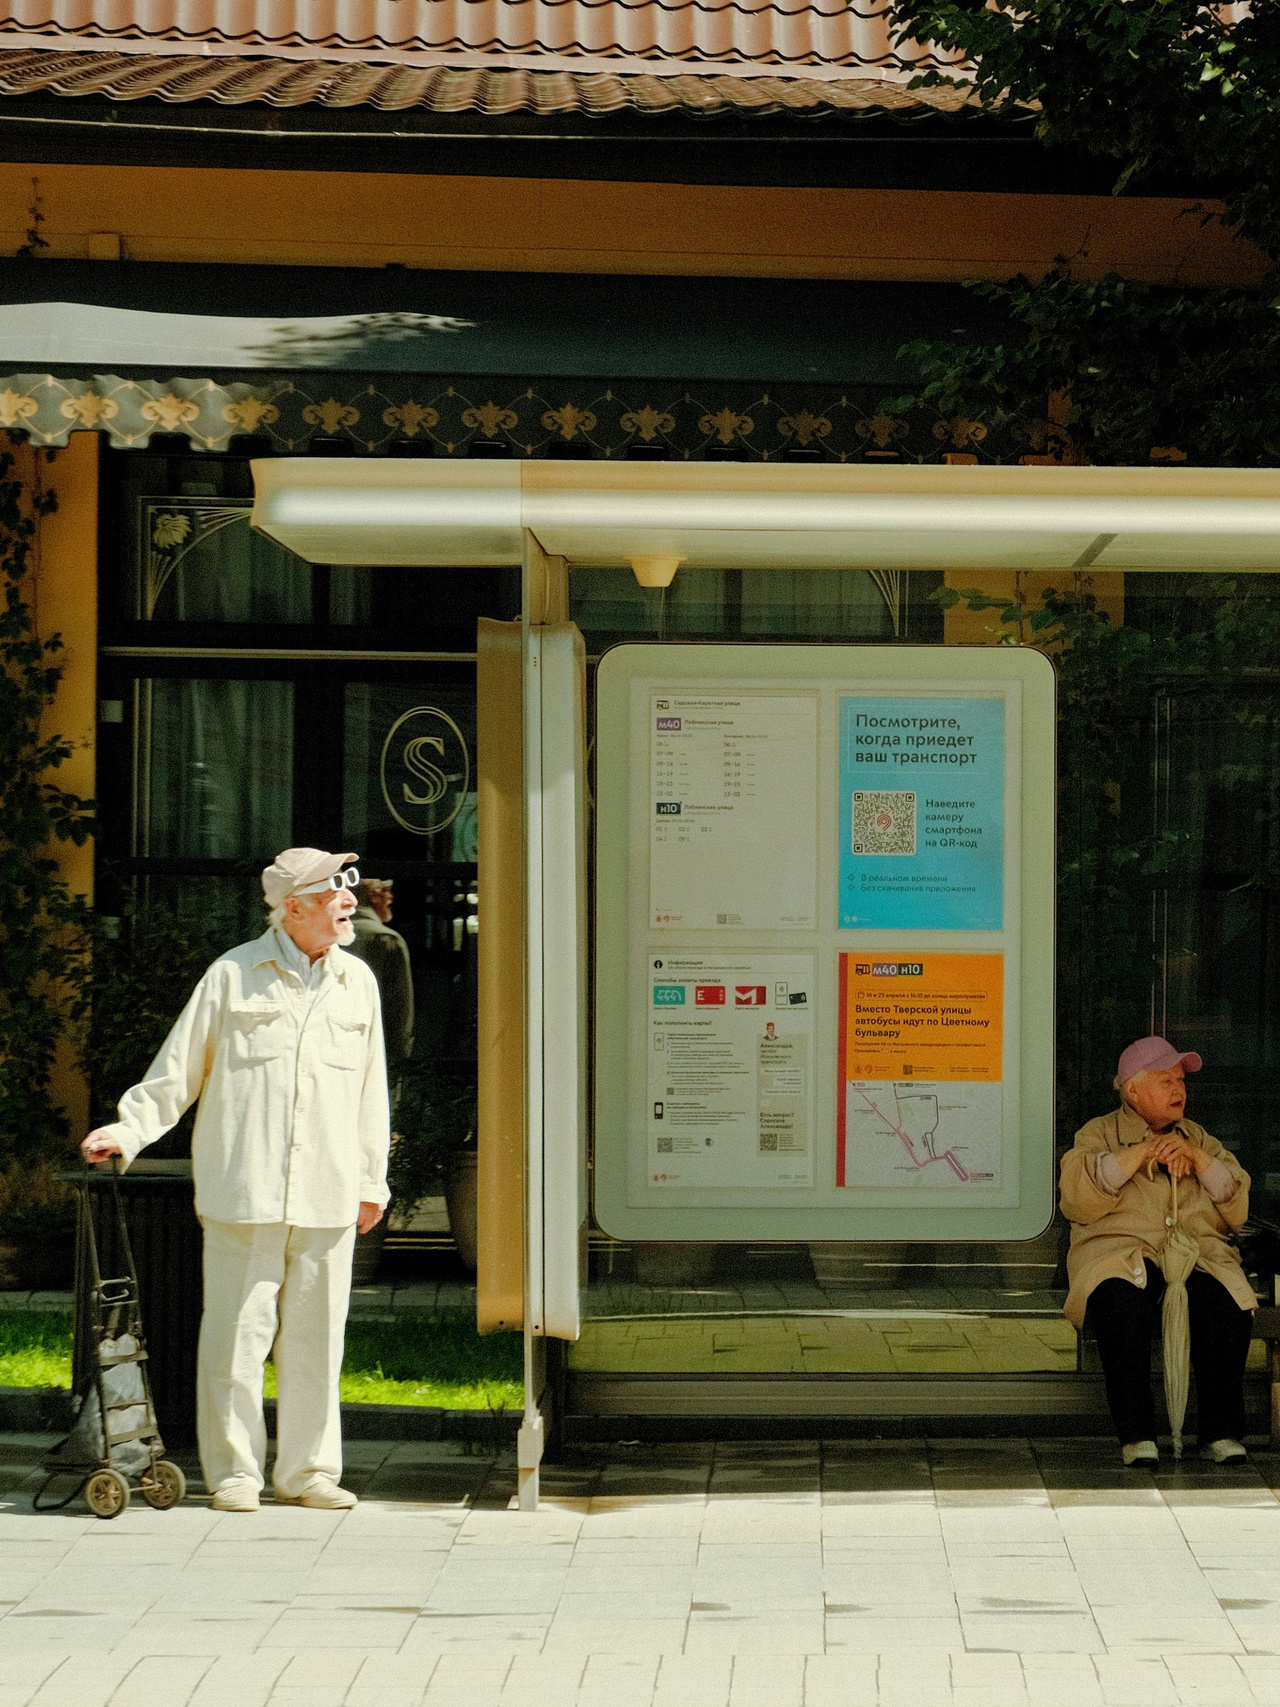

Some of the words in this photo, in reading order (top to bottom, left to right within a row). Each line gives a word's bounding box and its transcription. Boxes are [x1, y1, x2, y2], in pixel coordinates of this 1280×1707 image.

[658, 719, 680, 729] м40
[855, 714, 961, 731] Посмотрите,
[855, 735, 901, 748] когда
[905, 735, 975, 748] приедет
[855, 752, 888, 763] ваш
[891, 753, 977, 766] транспорт
[402, 736, 448, 804] S
[660, 804, 678, 814] н10
[925, 799, 976, 809] Наведите
[925, 813, 964, 823] камеру
[925, 825, 983, 837] смартфона
[939, 838, 978, 849] QR-код
[861, 873, 867, 881] В
[868, 875, 910, 884] реальном
[911, 875, 948, 883] времени
[860, 884, 876, 892] Без
[872, 964, 898, 975] м40
[900, 964, 921, 974] н10
[855, 1004, 891, 1014] Вместо
[893, 1004, 938, 1015] Тверской
[940, 1006, 972, 1015] улицы
[855, 1016, 901, 1027] автобусы
[902, 1018, 925, 1027] идут
[941, 1017, 990, 1028] Цветному
[854, 1028, 901, 1038] бульвару
